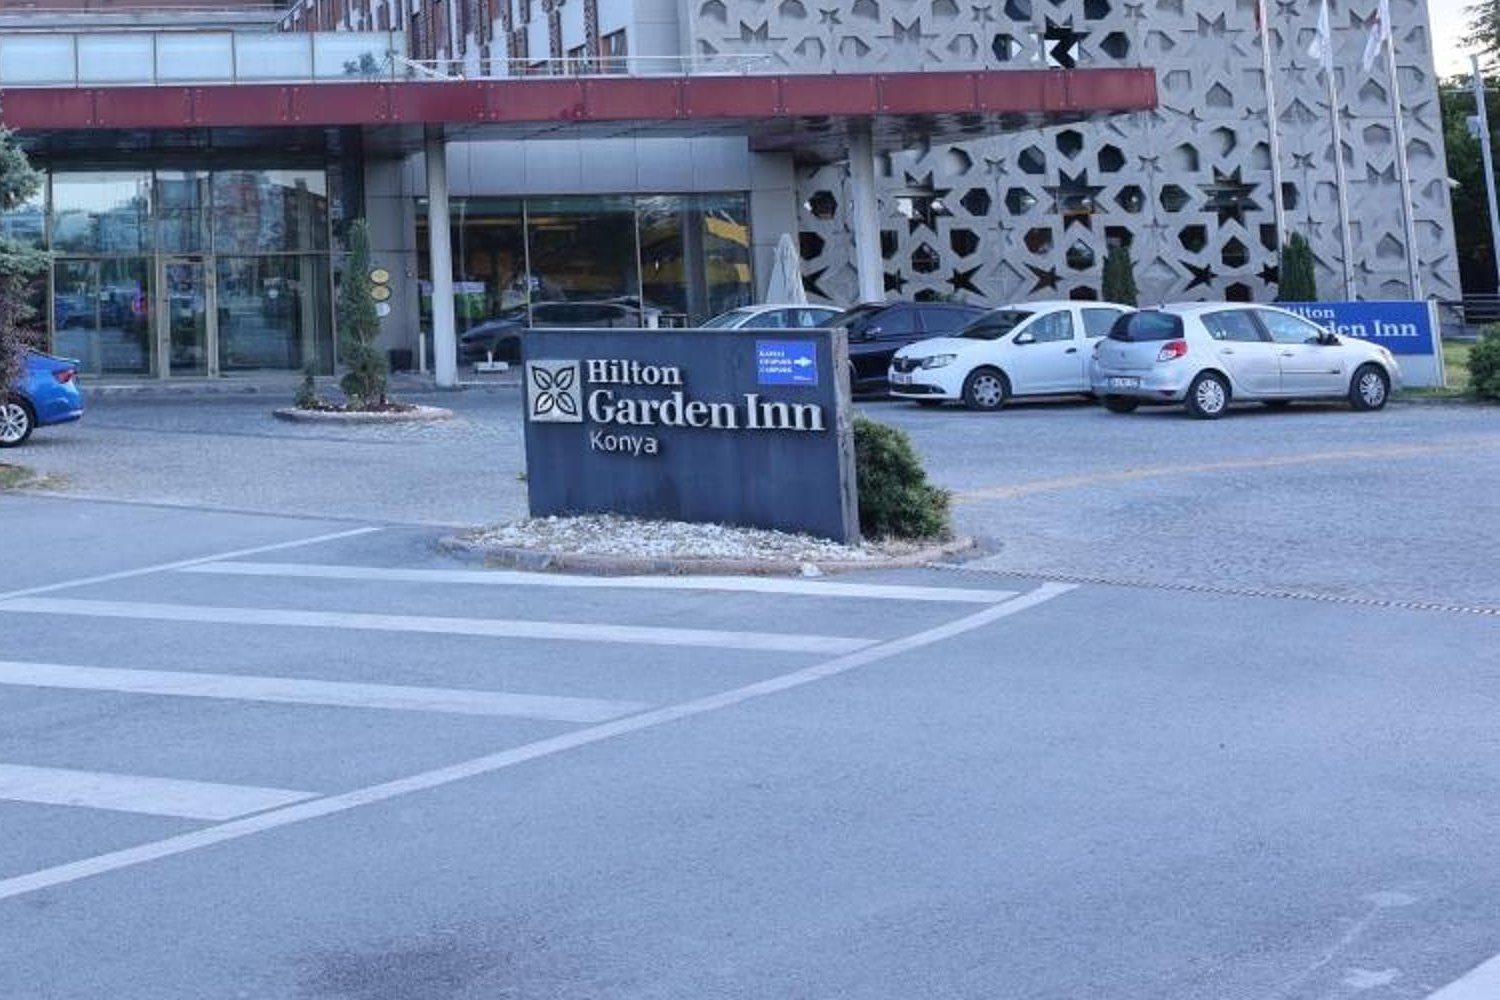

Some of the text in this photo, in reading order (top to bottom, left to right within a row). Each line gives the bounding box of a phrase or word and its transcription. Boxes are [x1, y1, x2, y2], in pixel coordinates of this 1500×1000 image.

[1373, 319, 1419, 337] Inn
[586, 359, 683, 386] Hilton
[587, 388, 827, 432] Garden Inn
[589, 431, 659, 457] Konya
